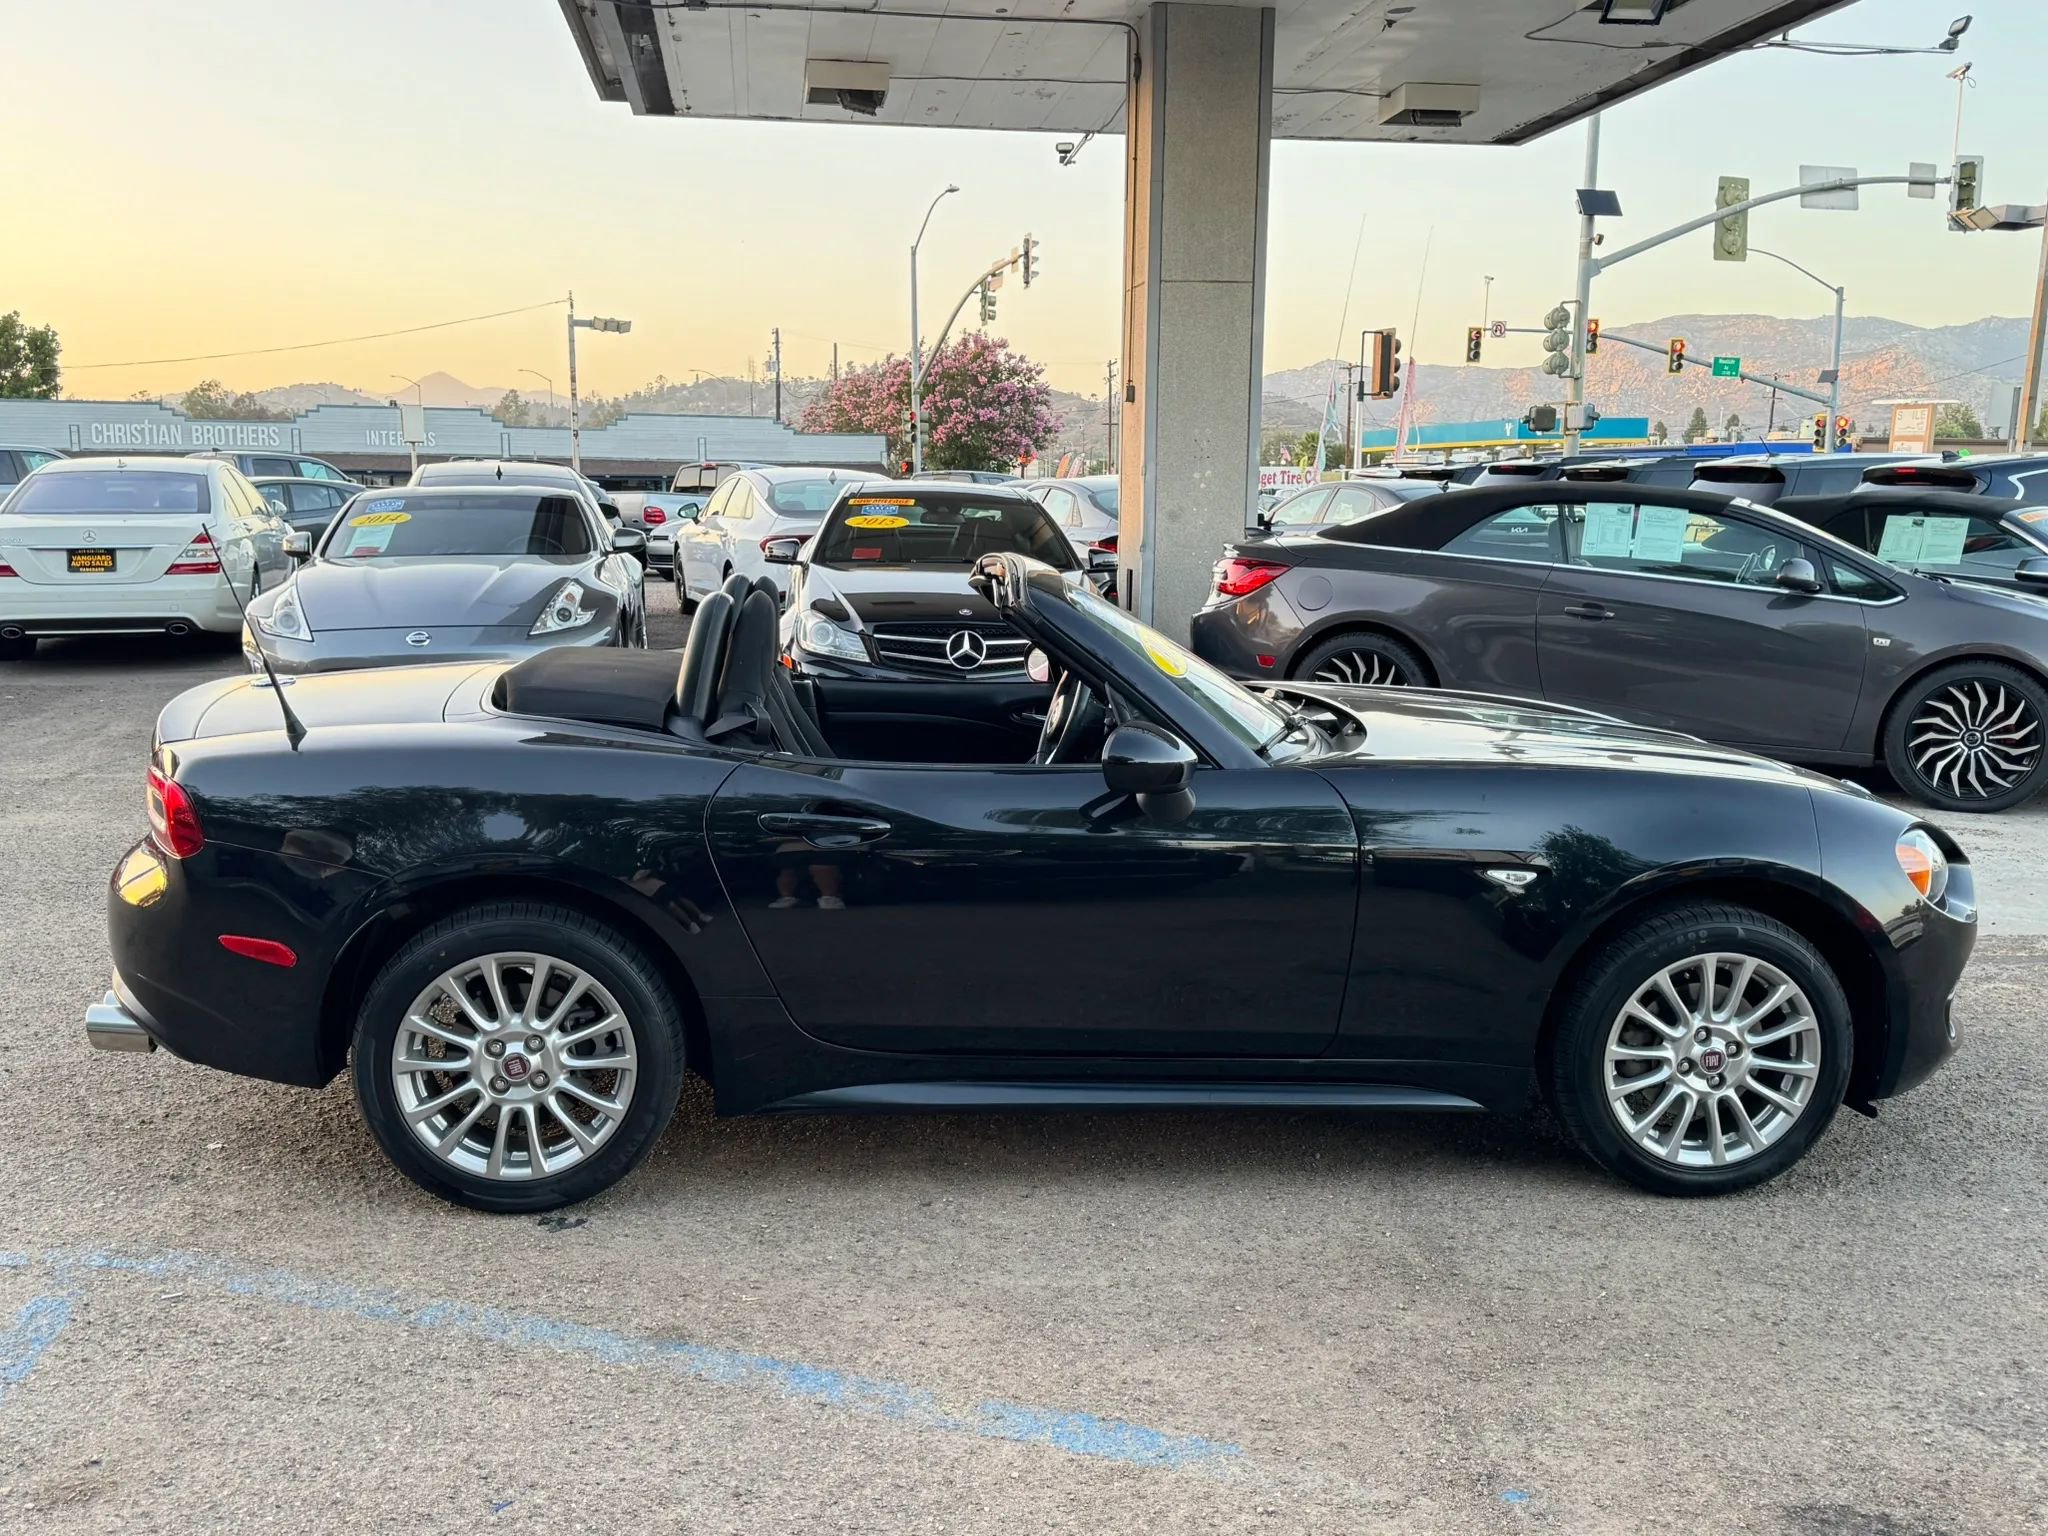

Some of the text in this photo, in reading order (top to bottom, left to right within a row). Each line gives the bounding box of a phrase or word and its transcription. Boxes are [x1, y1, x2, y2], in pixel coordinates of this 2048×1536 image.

[91, 419, 281, 447] CHRISTIAN BROTHERS
[366, 429, 436, 447] INTERRS
[1258, 471, 1277, 488] get
[1280, 470, 1302, 485] Tire
[855, 518, 898, 526] 2015
[1705, 1055, 1720, 1067] FIAT
